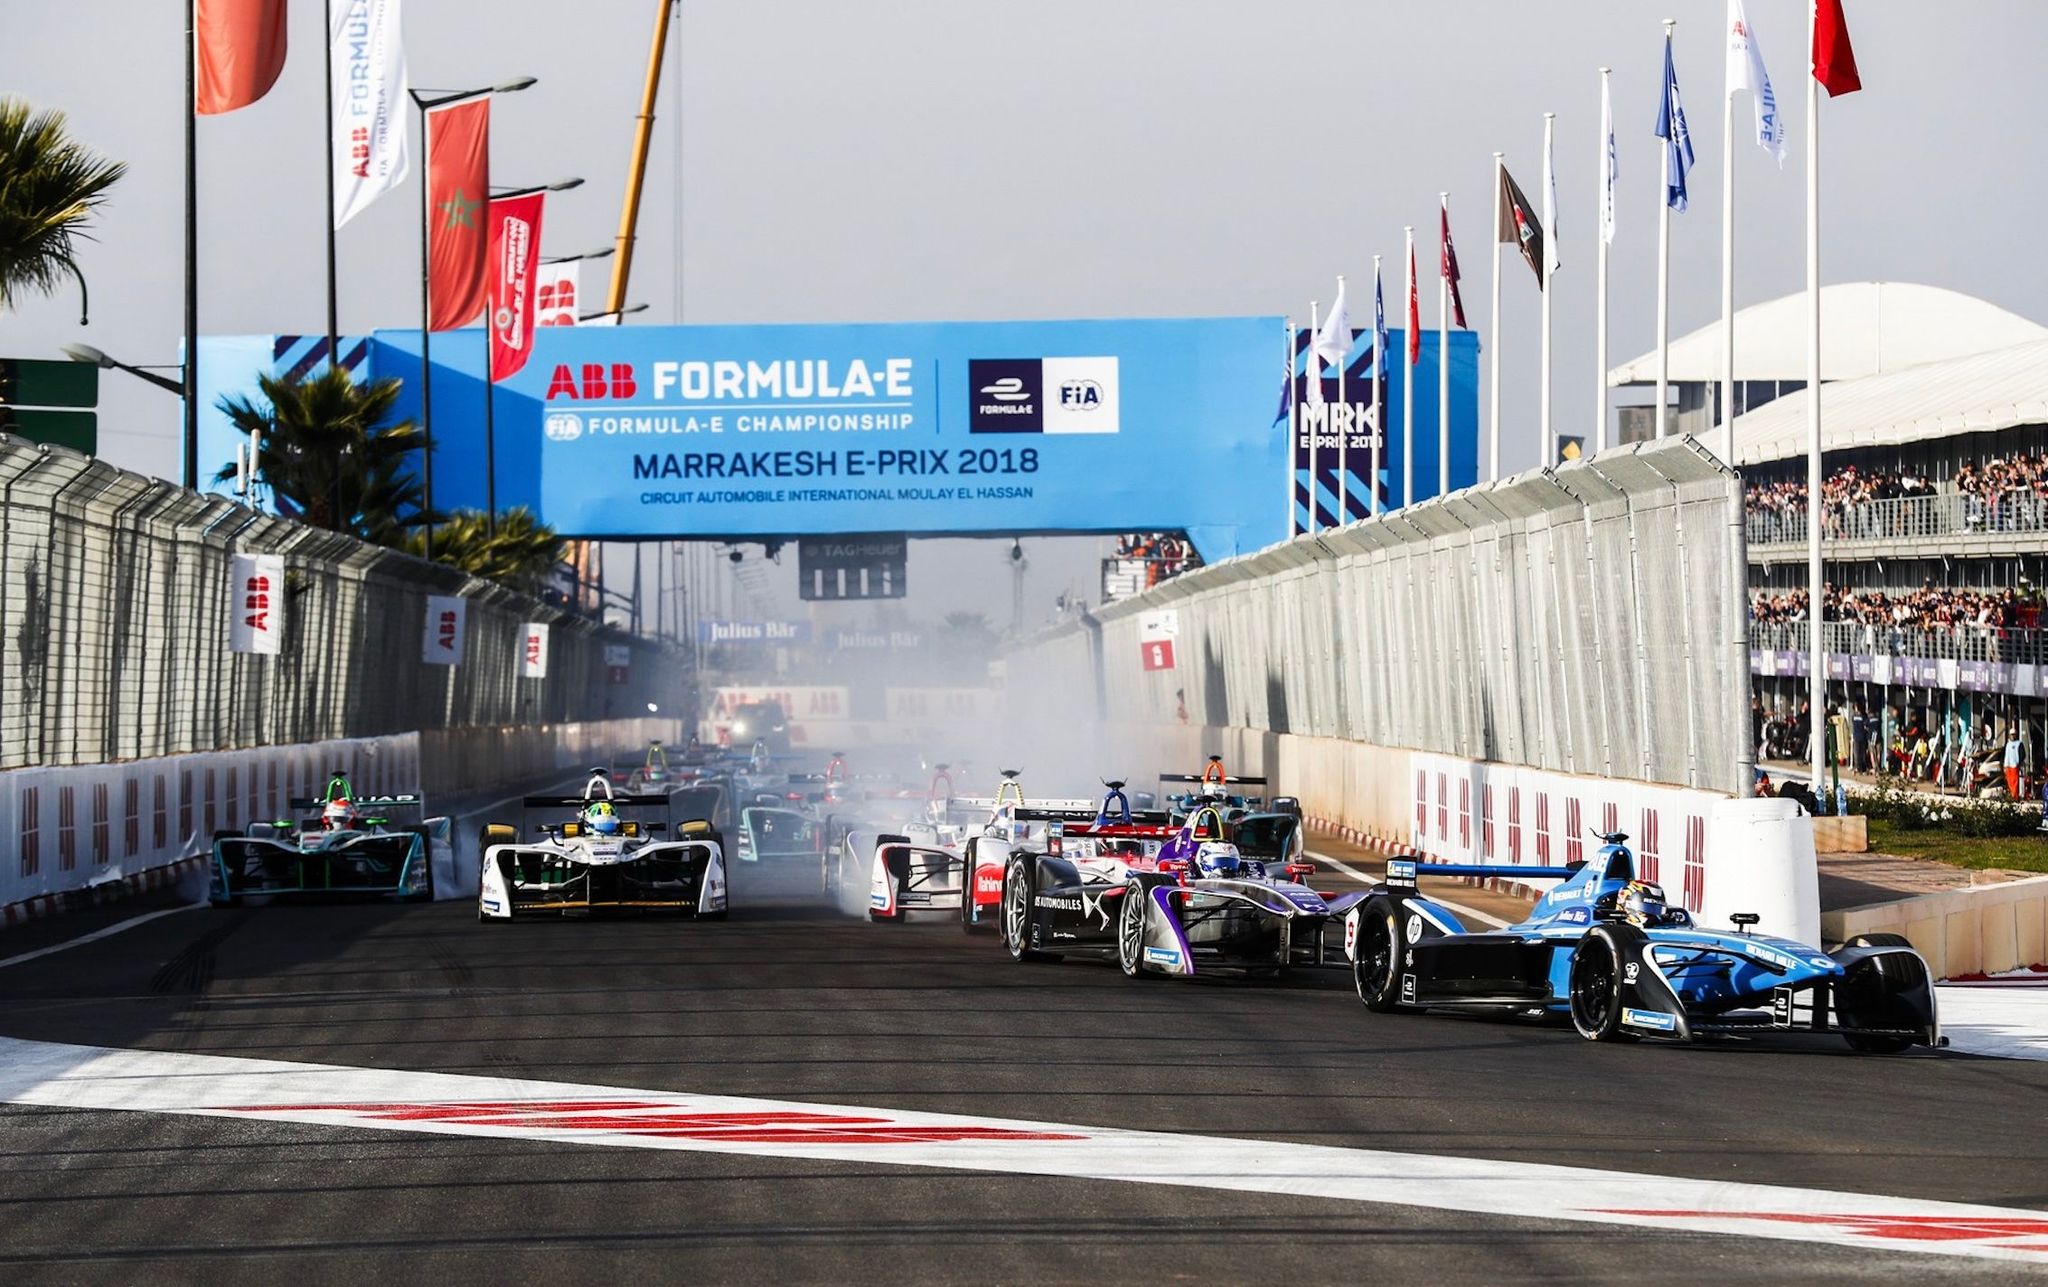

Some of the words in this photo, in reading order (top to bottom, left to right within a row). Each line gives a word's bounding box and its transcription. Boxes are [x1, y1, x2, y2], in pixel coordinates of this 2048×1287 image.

[348, 0, 370, 116] FORMUL
[351, 127, 370, 178] ABB
[546, 363, 637, 400] ABB
[653, 358, 913, 400] FORMULA-E
[588, 416, 724, 435] FORMULA-E
[737, 413, 914, 432] CHAMPIONSHIP
[980, 405, 1033, 415] FORMULA-E
[1300, 402, 1382, 433] MRK
[1300, 435, 1348, 448] EPRIX
[633, 450, 837, 480] MARRAKESH
[846, 448, 950, 476] E-PRIX
[958, 448, 1039, 475] 2018
[640, 491, 693, 505] CIRCUIT
[697, 490, 785, 503] AUTOMOBILE
[788, 488, 894, 502] INTERNATIONAL
[897, 487, 955, 501] MOULAY
[957, 487, 974, 499] EL
[976, 486, 1034, 499] HASSAN
[245, 576, 269, 631] ABB
[438, 610, 457, 650] ABB
[711, 622, 762, 641] Julius
[765, 621, 799, 639] Bär
[838, 632, 888, 649] Julius
[527, 636, 540, 665] ABB
[810, 691, 841, 714] ABB
[1683, 815, 1704, 914] ABB
[1040, 896, 1082, 910] AUTOMOBILES
